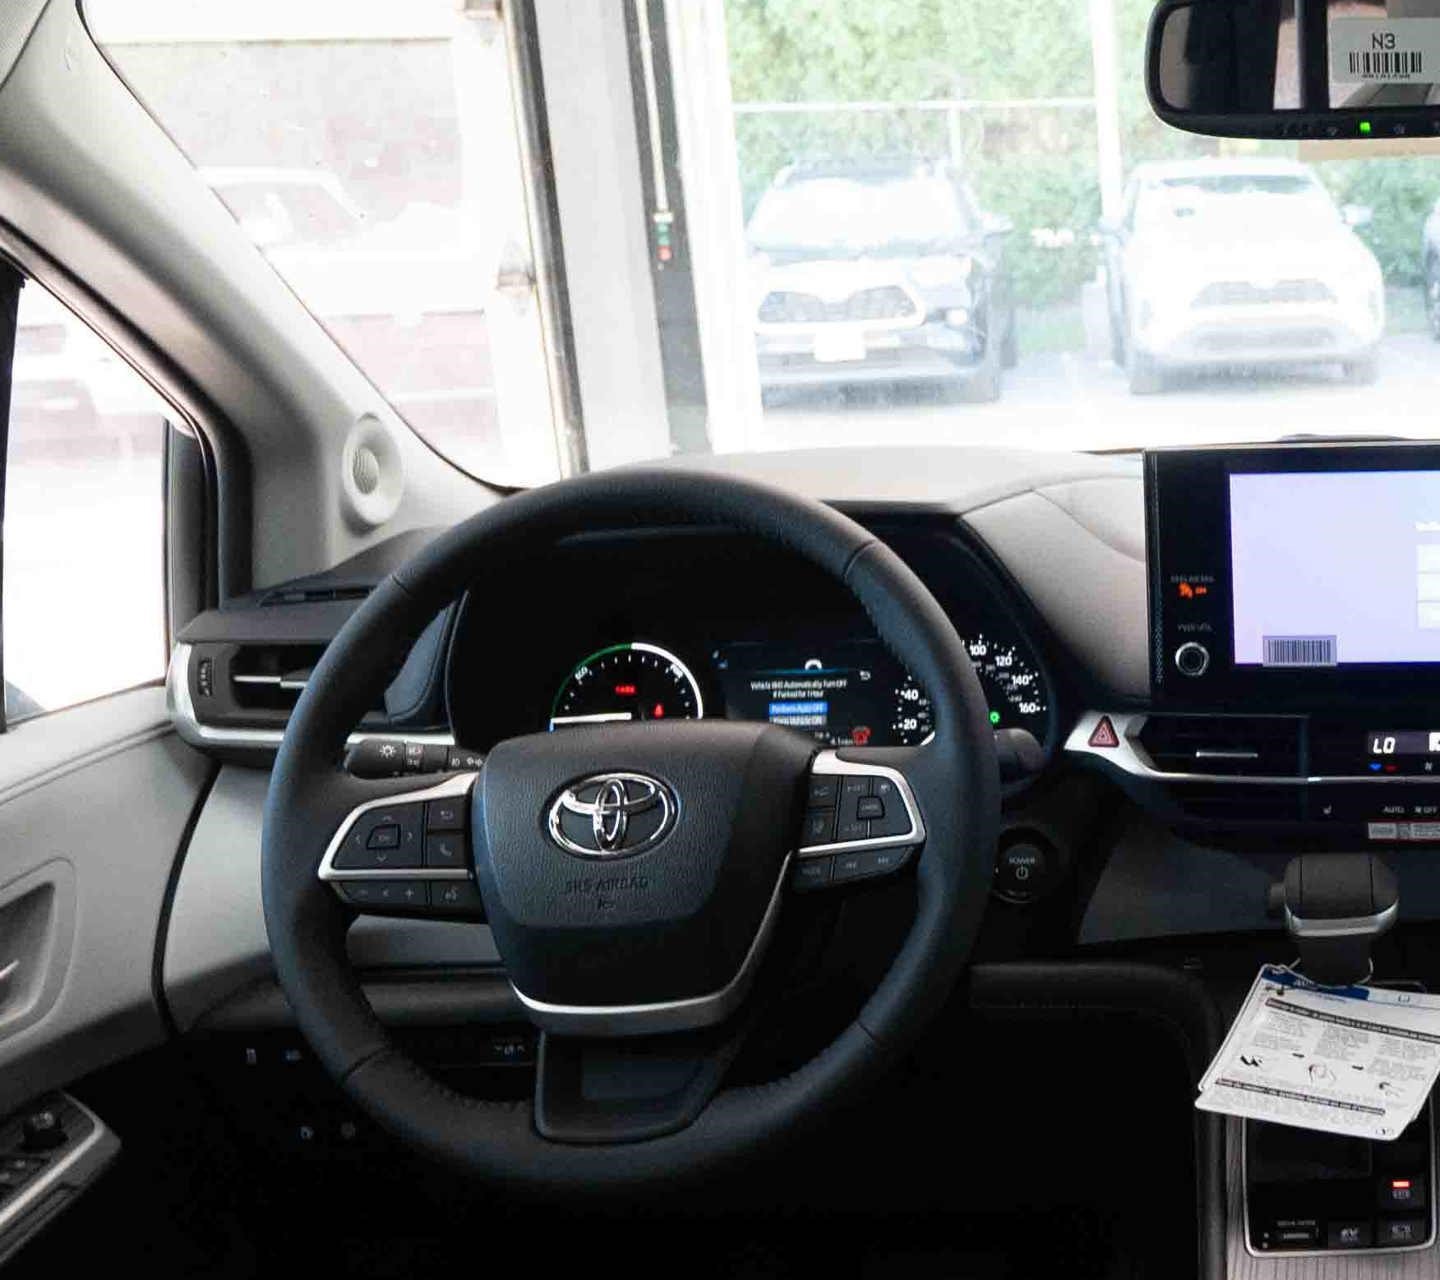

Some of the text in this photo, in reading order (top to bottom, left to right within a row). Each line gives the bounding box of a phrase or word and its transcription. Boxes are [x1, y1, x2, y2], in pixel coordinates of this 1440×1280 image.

[1372, 32, 1396, 50] N3
[969, 644, 987, 656] 100
[995, 656, 1012, 667] 120
[1011, 674, 1030, 686] 140
[904, 689, 919, 701] 40
[1018, 702, 1036, 713] 160
[903, 718, 917, 730] 20
[1373, 737, 1396, 754] LO
